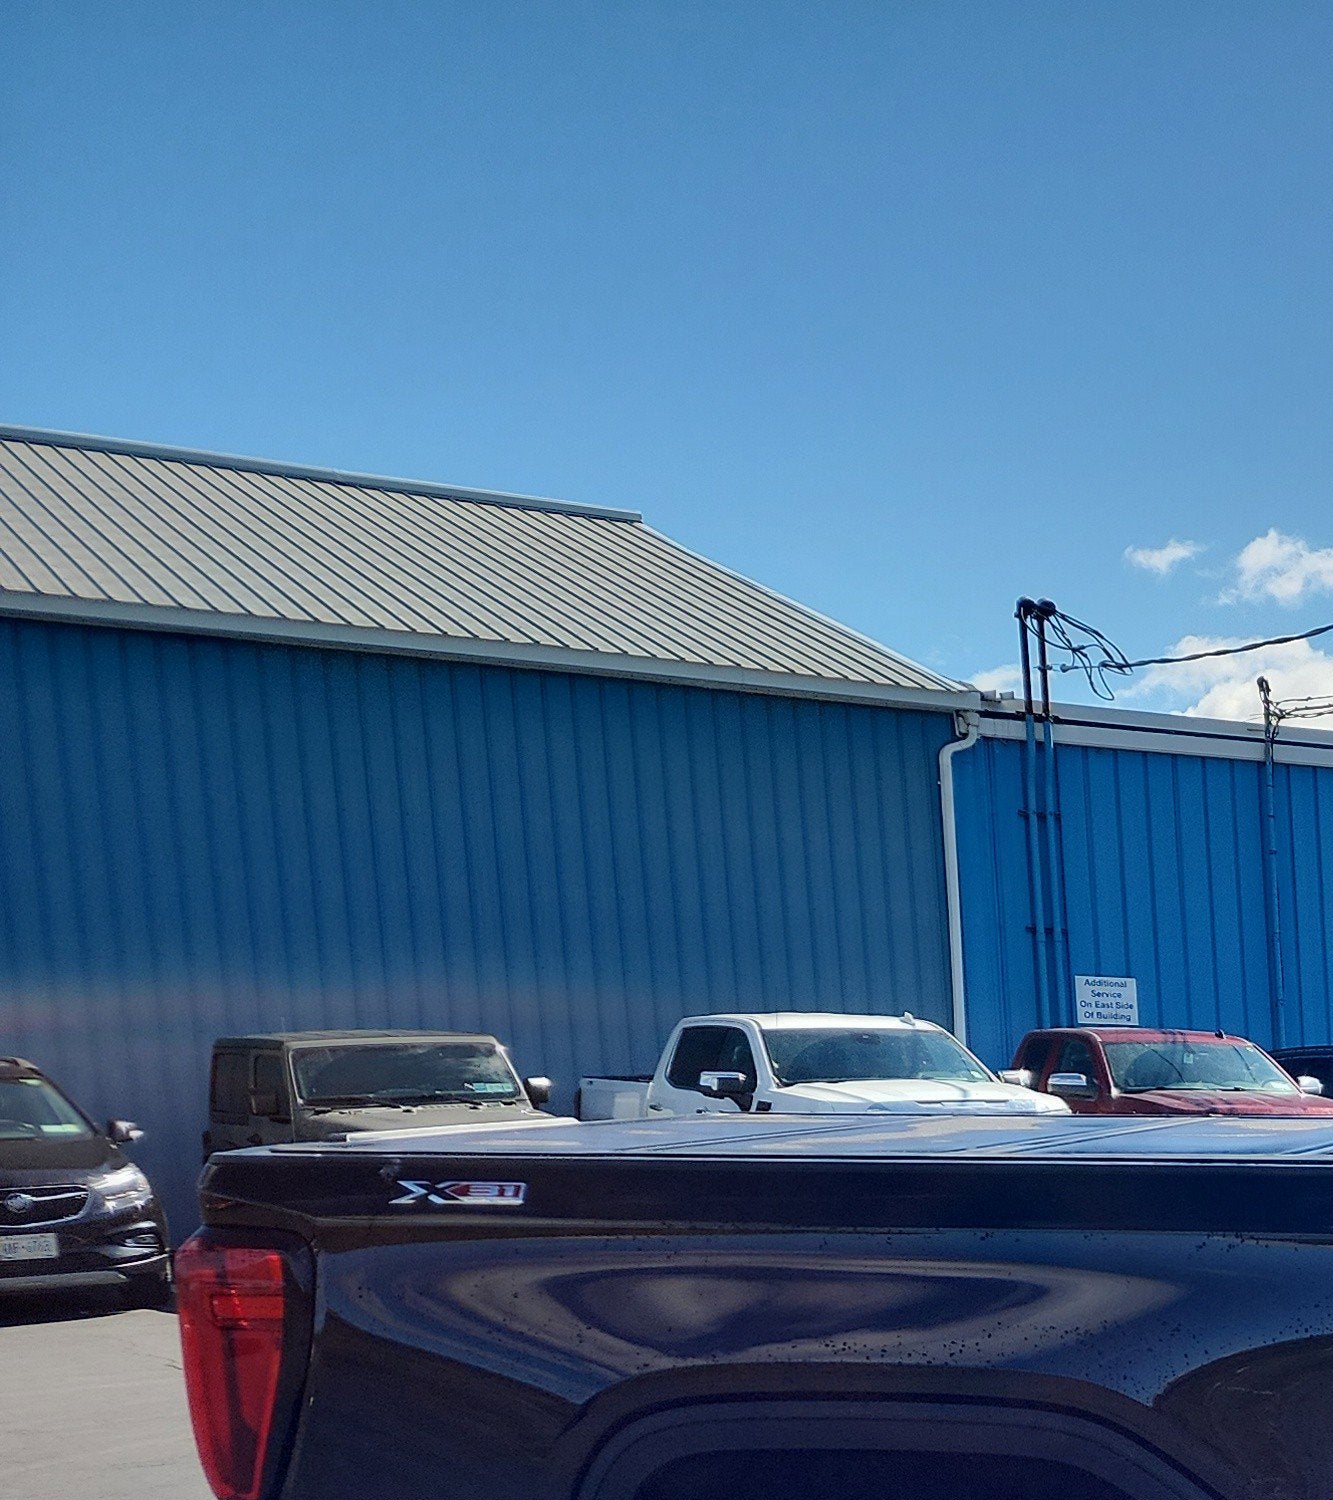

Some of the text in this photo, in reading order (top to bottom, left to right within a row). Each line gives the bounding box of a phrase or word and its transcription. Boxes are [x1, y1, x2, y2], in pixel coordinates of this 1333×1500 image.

[1084, 978, 1127, 988] Additional
[1090, 989, 1122, 999] Service
[1080, 1000, 1134, 1010] On East Side
[1083, 1010, 1132, 1022] Of Building
